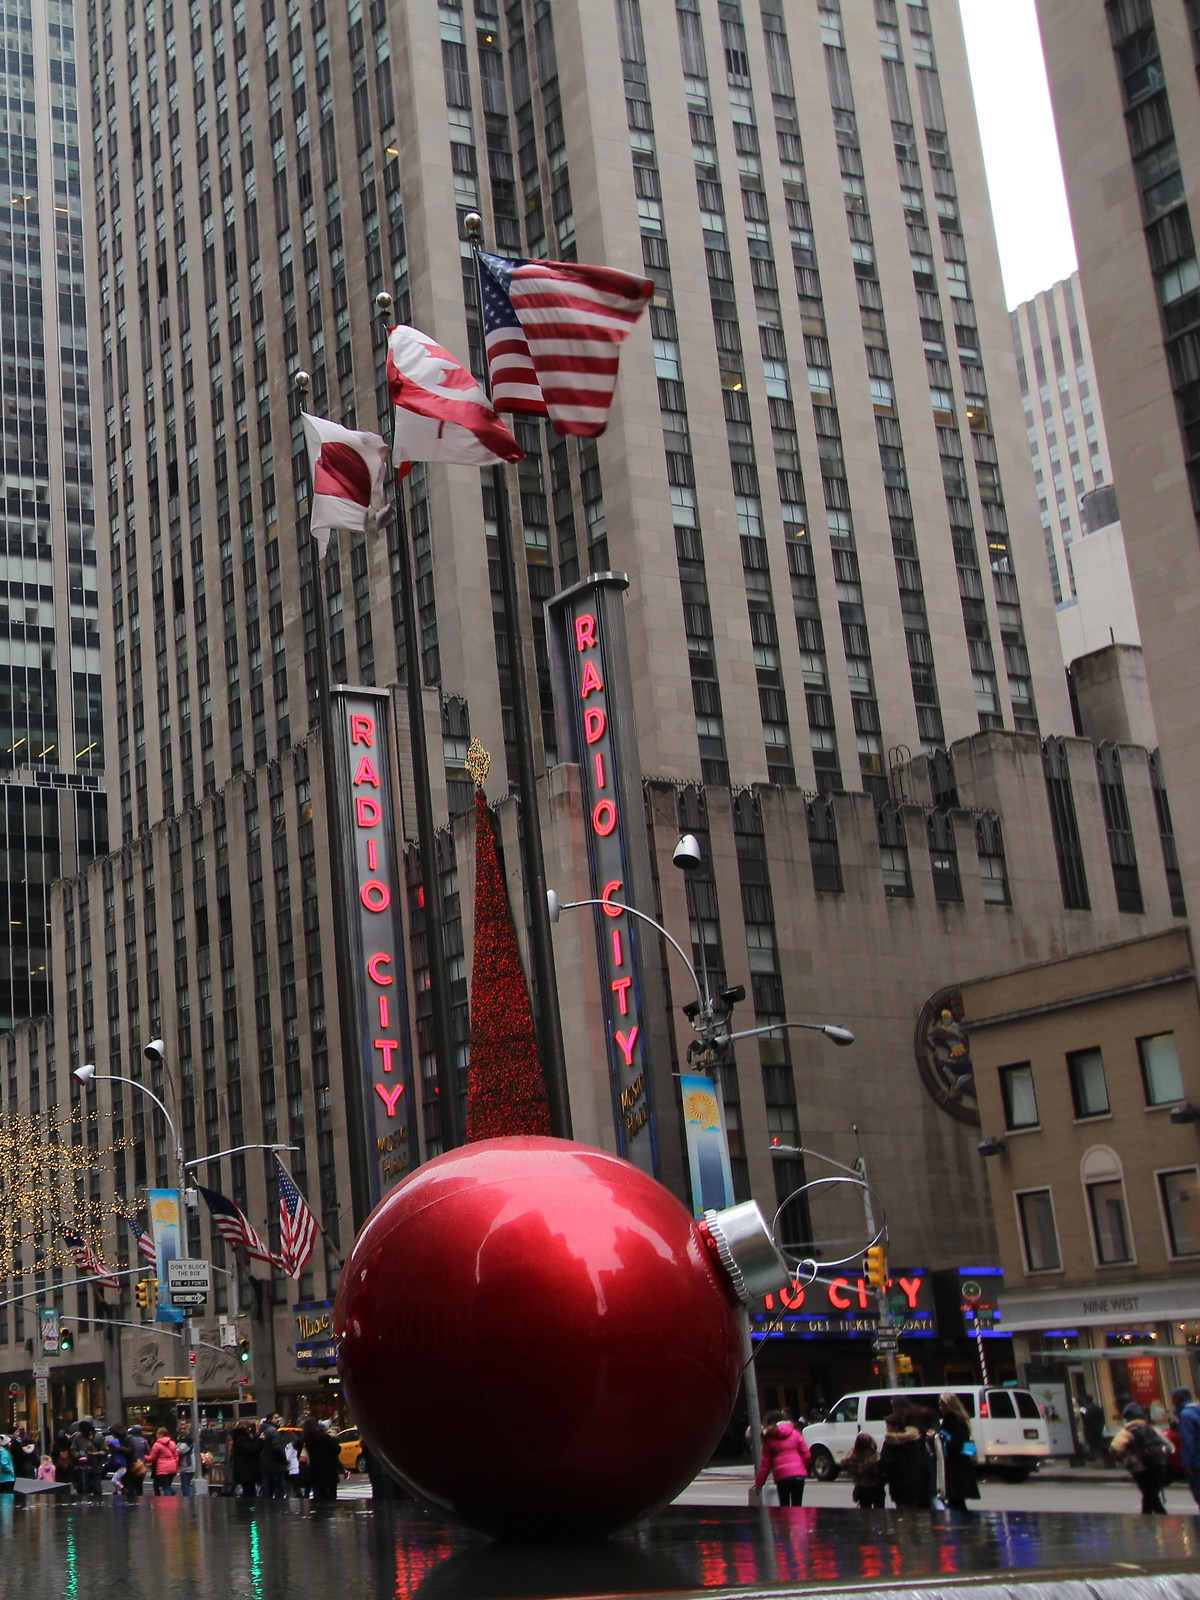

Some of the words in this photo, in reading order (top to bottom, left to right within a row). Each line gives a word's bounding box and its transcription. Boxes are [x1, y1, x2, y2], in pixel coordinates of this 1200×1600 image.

[351, 713, 391, 913] RADIO
[574, 613, 617, 837] RADIO
[601, 880, 639, 1066] CITY
[367, 951, 404, 1117] CITY
[828, 1277, 922, 1309] CIY
[1083, 1300, 1108, 1314] NINE
[1110, 1297, 1138, 1311] WEST
[761, 1322, 783, 1331] JAN
[790, 1322, 797, 1331] 2
[808, 1321, 830, 1331] GET
[839, 1320, 877, 1331] TICKET
[297, 1350, 313, 1359] CHASE
